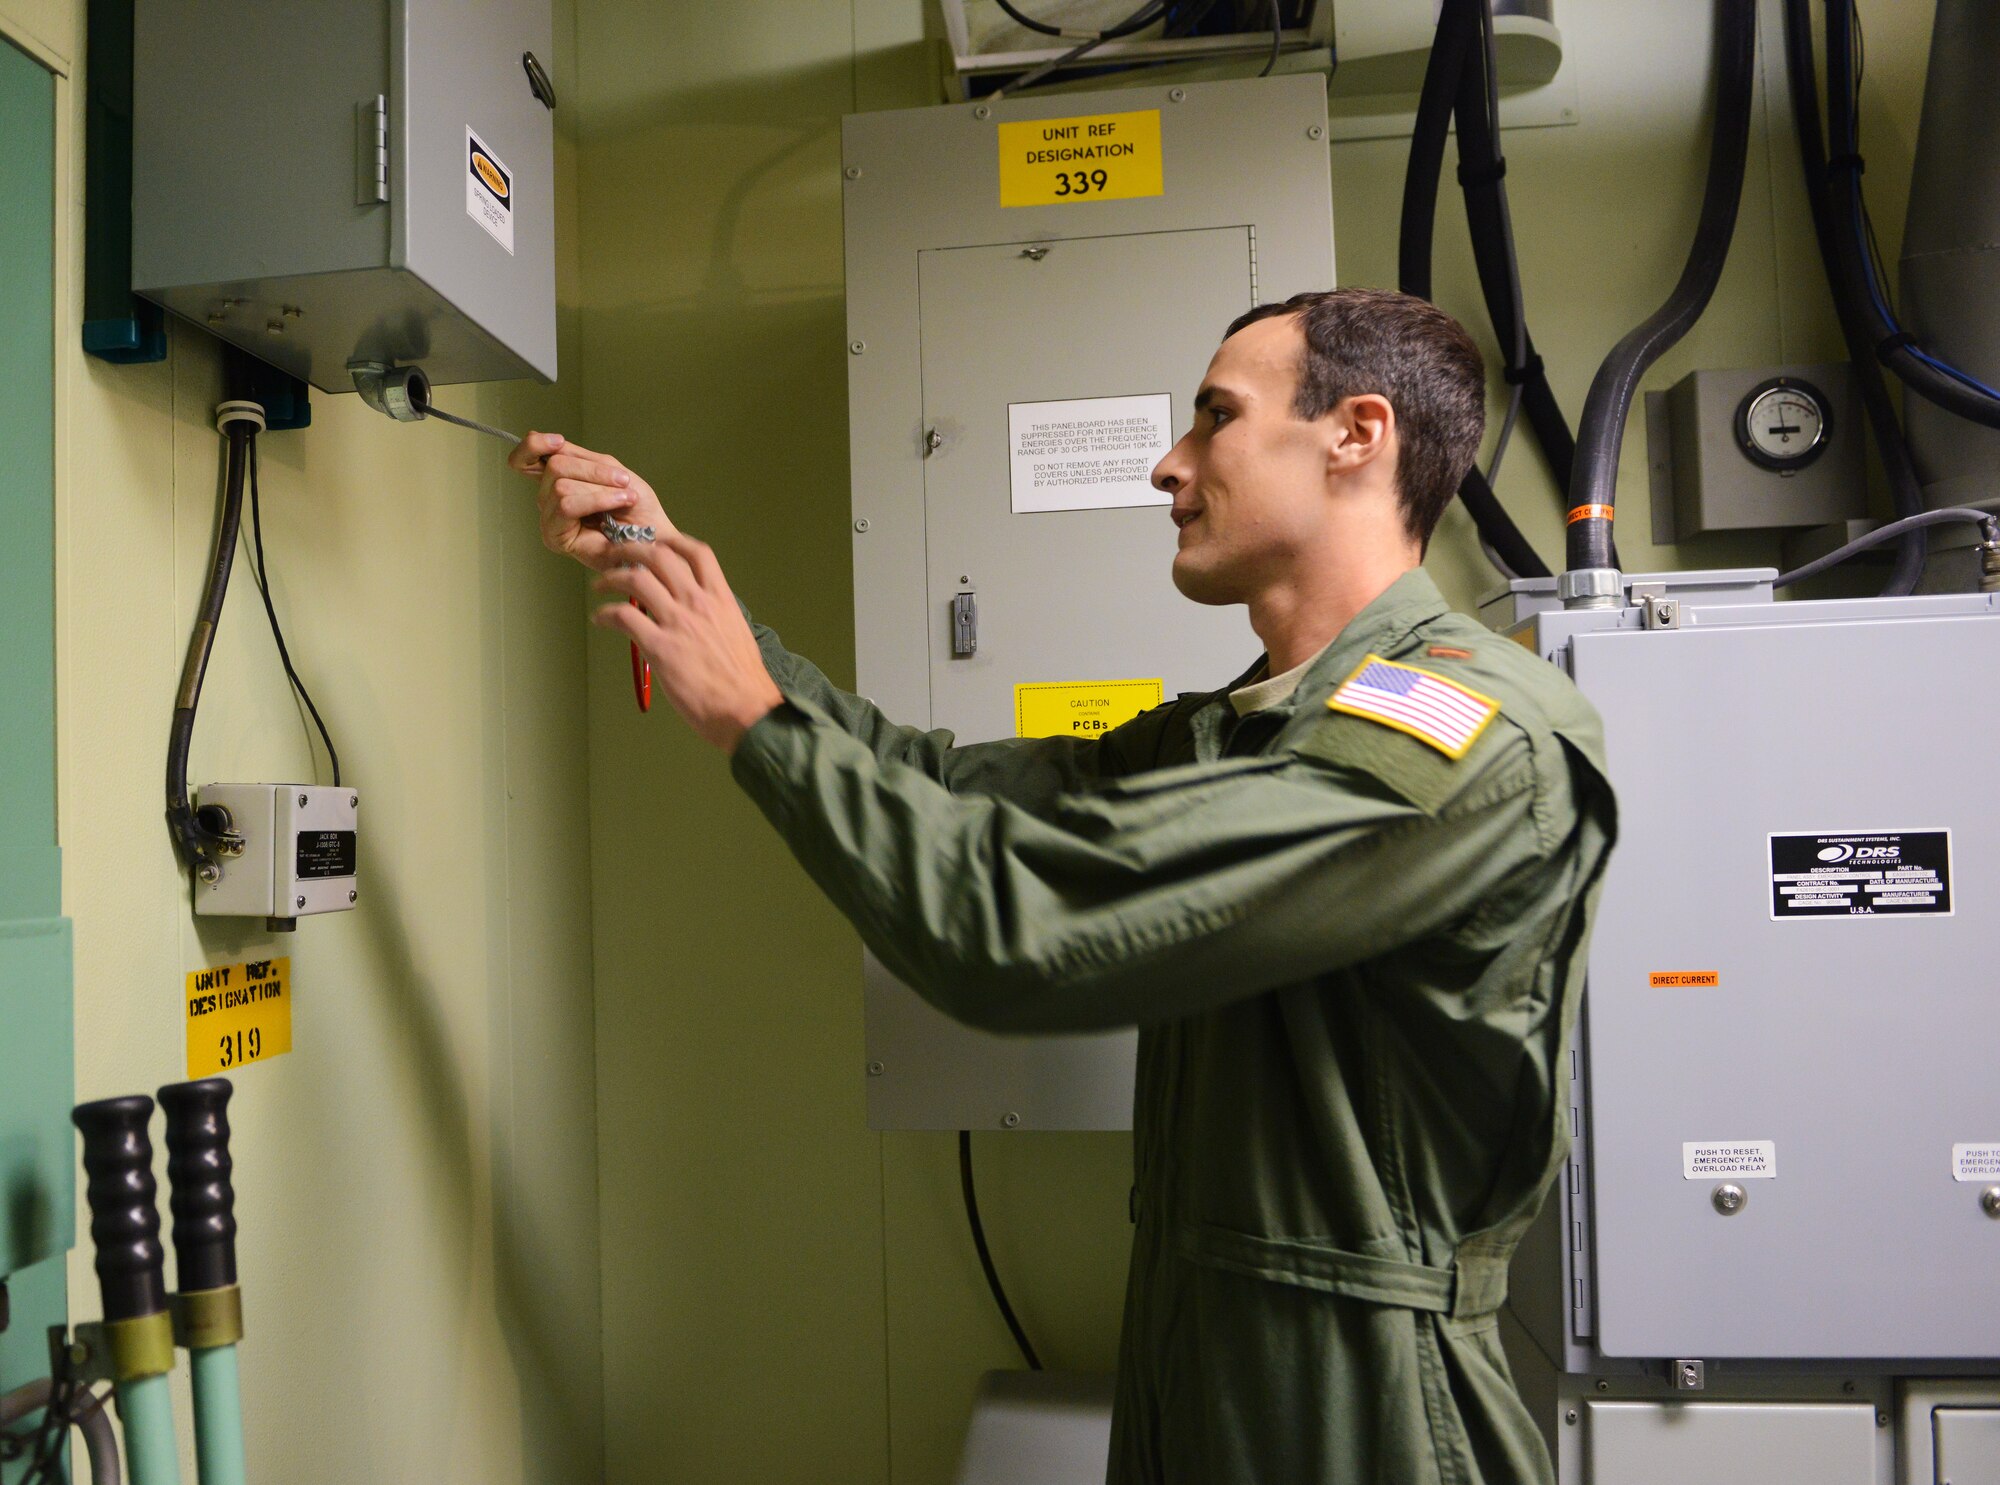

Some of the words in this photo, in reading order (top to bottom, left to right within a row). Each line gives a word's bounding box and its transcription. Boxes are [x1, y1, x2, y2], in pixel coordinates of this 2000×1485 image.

[1043, 126, 1079, 141] UNIT
[1088, 123, 1115, 136] REF
[1027, 143, 1134, 164] DESIGNATION
[483, 166, 504, 191] WARNING
[1055, 169, 1107, 196] 339
[474, 187, 489, 209] SPRING
[489, 203, 505, 224] LOADED
[483, 208, 498, 227] DEVICE
[1021, 431, 1074, 440] SUPPRESSED
[1096, 425, 1158, 435] INTERFERENCE
[1052, 420, 1105, 430] PANELBOARD
[1022, 440, 1062, 448] ENERGIES
[1108, 433, 1157, 442] FREQUENCY
[1018, 448, 1045, 456] RANGE
[1091, 443, 1131, 451] THROUGH
[1035, 471, 1068, 479] COVERS
[1104, 466, 1149, 475] APPROVED
[1067, 461, 1100, 469] REMOVE
[1046, 477, 1098, 486] AUTHORIZED
[1101, 475, 1149, 483] PERSONNEL
[1070, 699, 1110, 708] CAUTION
[1073, 720, 1108, 730] PCBs
[1855, 846, 1900, 858] DRS
[196, 968, 230, 992] UNIT
[1653, 976, 1679, 984] DIRECT
[190, 981, 281, 1017] DESIGNATION
[220, 1027, 261, 1067] 319
